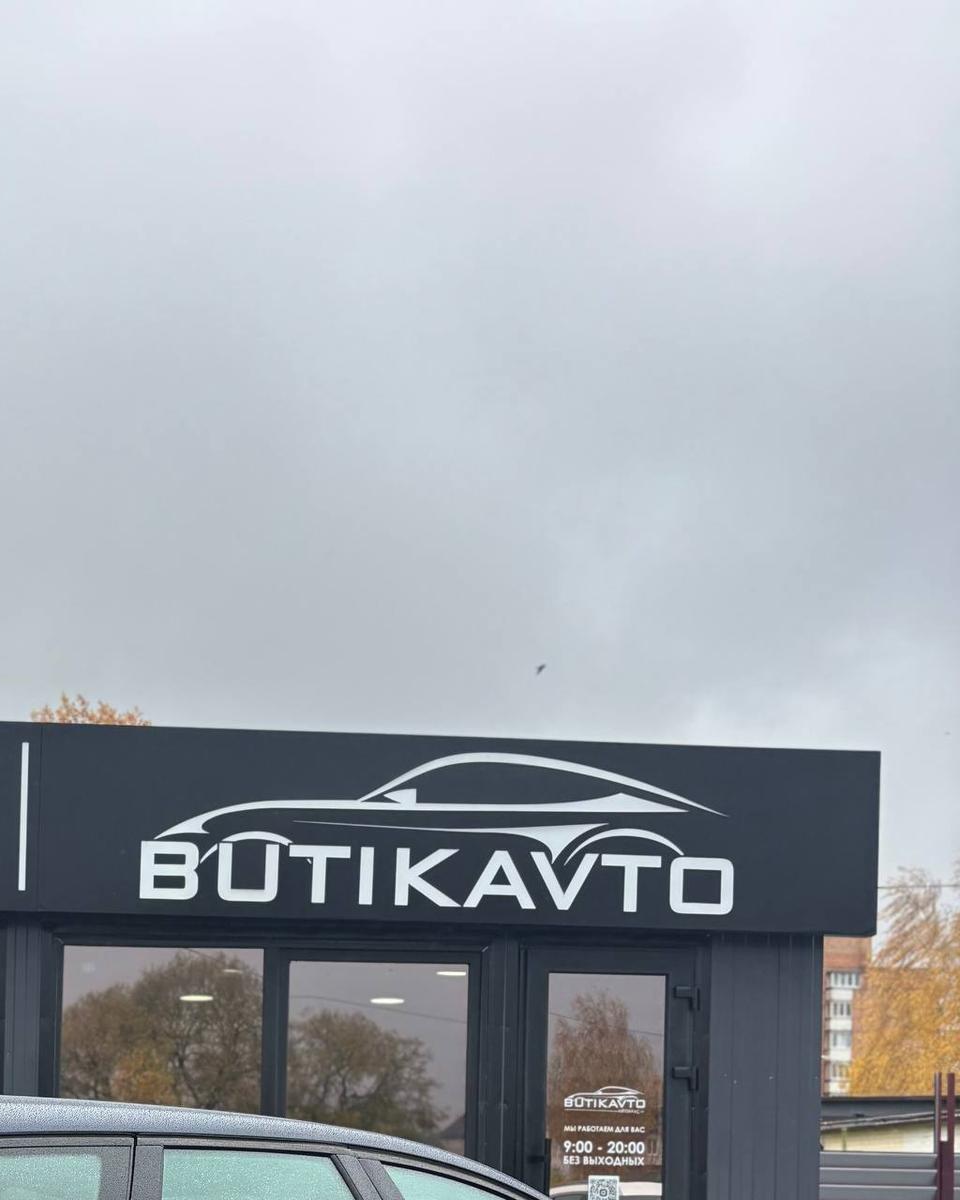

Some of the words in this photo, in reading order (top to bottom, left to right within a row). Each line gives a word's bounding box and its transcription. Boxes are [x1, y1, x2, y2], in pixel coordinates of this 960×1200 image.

[140, 840, 734, 916] BUTIKAVTO
[563, 1097, 646, 1109] BUTIKAVTO
[578, 1125, 613, 1133] РАБОТАЕМ
[563, 1140, 593, 1153] 9:00
[607, 1141, 645, 1154] 20:00
[563, 1155, 580, 1165] БЕЗ
[583, 1155, 645, 1167] ВЫХОДНЫХ
